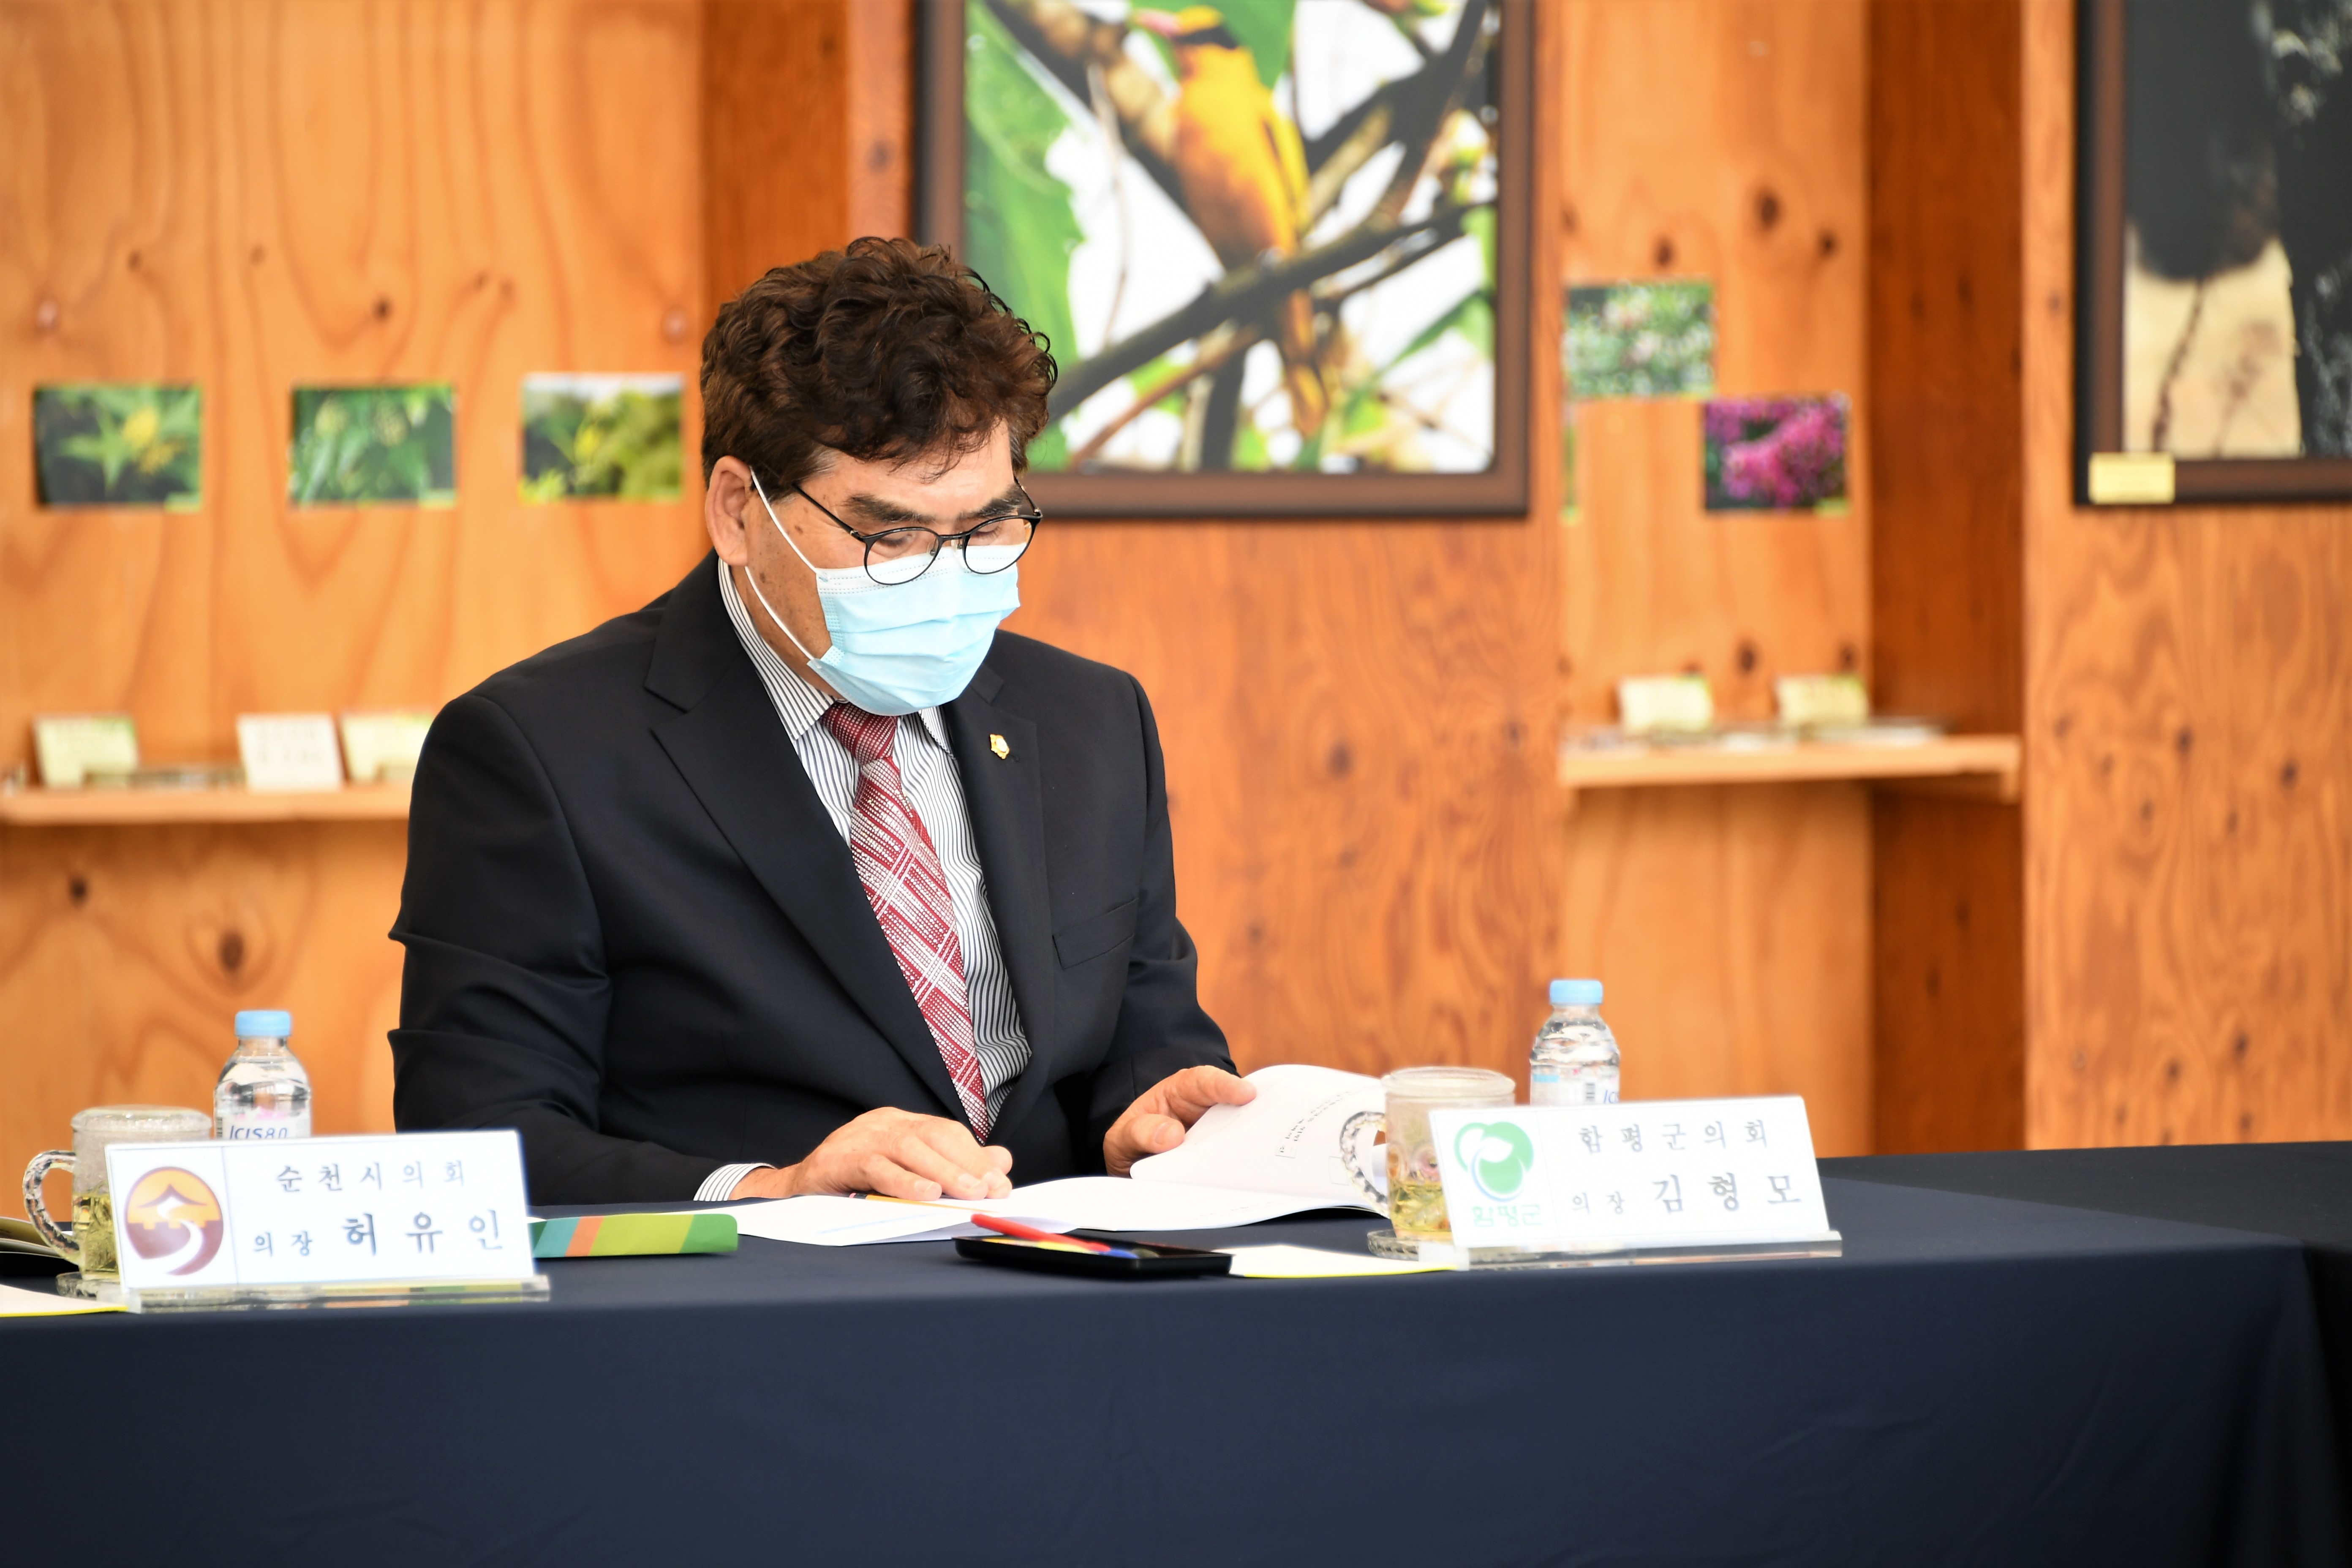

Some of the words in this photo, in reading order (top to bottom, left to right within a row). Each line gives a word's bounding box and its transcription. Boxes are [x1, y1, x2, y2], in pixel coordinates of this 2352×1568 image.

[1578, 1119, 1767, 1154] 함평군의회
[277, 1160, 464, 1192] 순천시의회
[1572, 1190, 1625, 1215] 의장
[1651, 1172, 1802, 1214] 김형모
[253, 1231, 313, 1257] 의장
[342, 1209, 503, 1256] 허유인
[1471, 1204, 1542, 1227] 함평군
